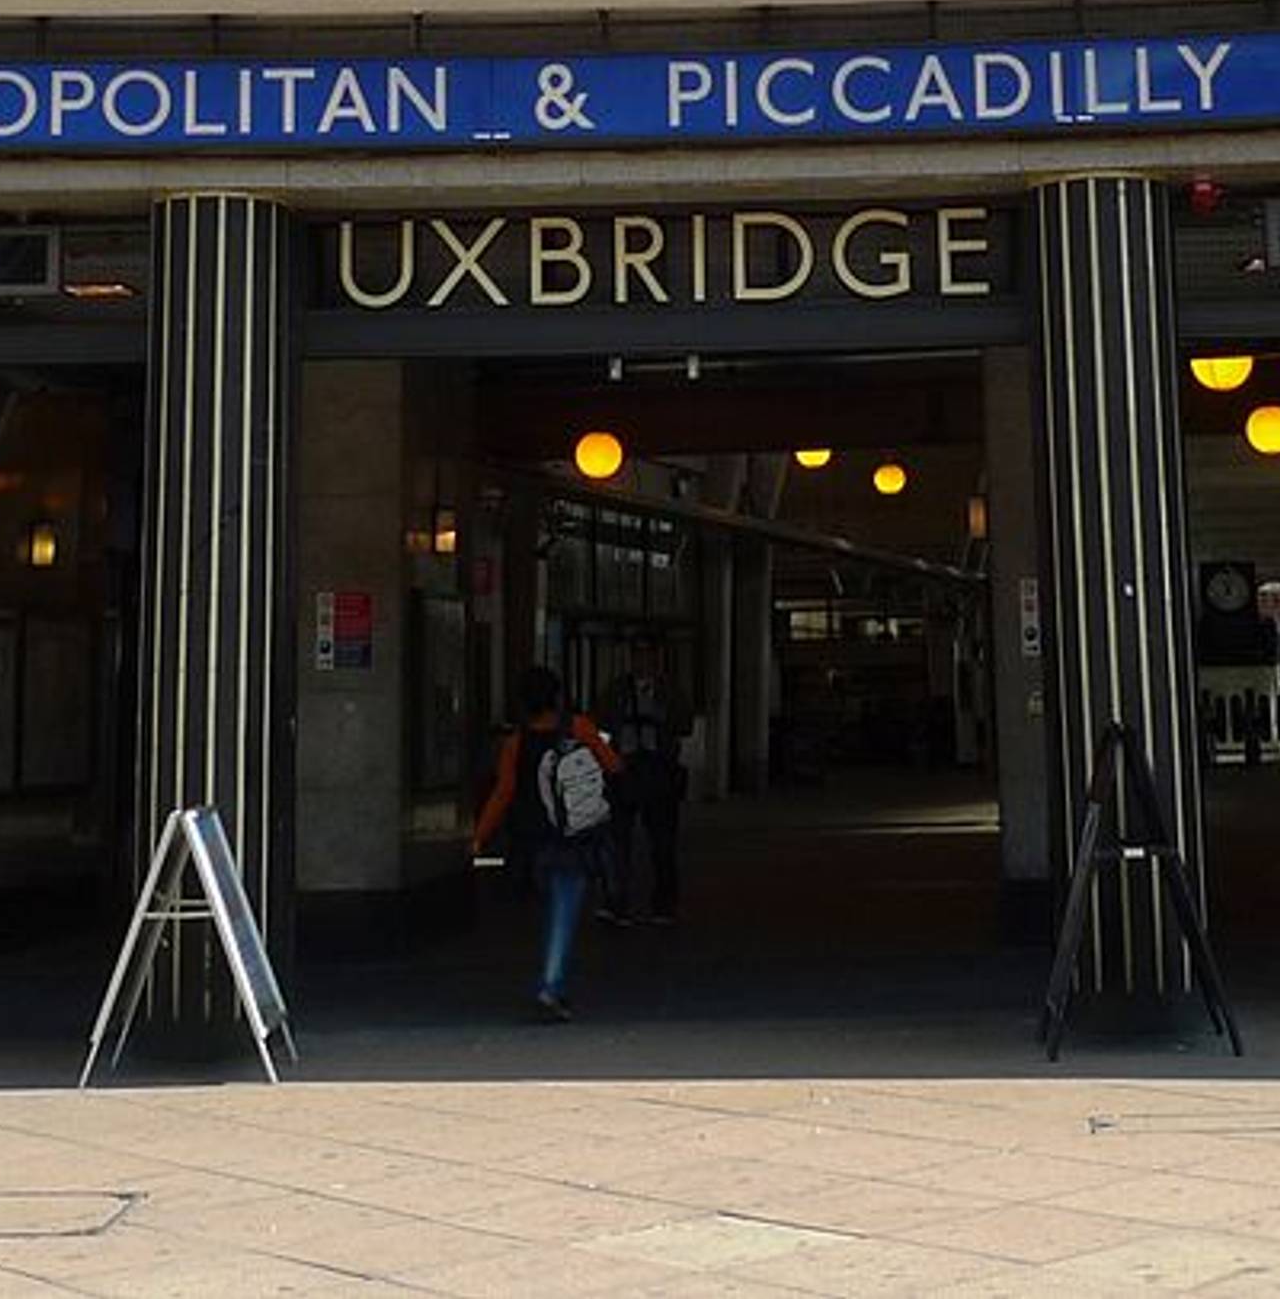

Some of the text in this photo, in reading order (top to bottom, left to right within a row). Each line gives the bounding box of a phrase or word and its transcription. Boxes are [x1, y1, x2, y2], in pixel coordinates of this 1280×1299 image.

[535, 64, 594, 130] &
[667, 43, 1232, 127] PICCADILLY
[341, 209, 990, 307] UXBRIDGE
